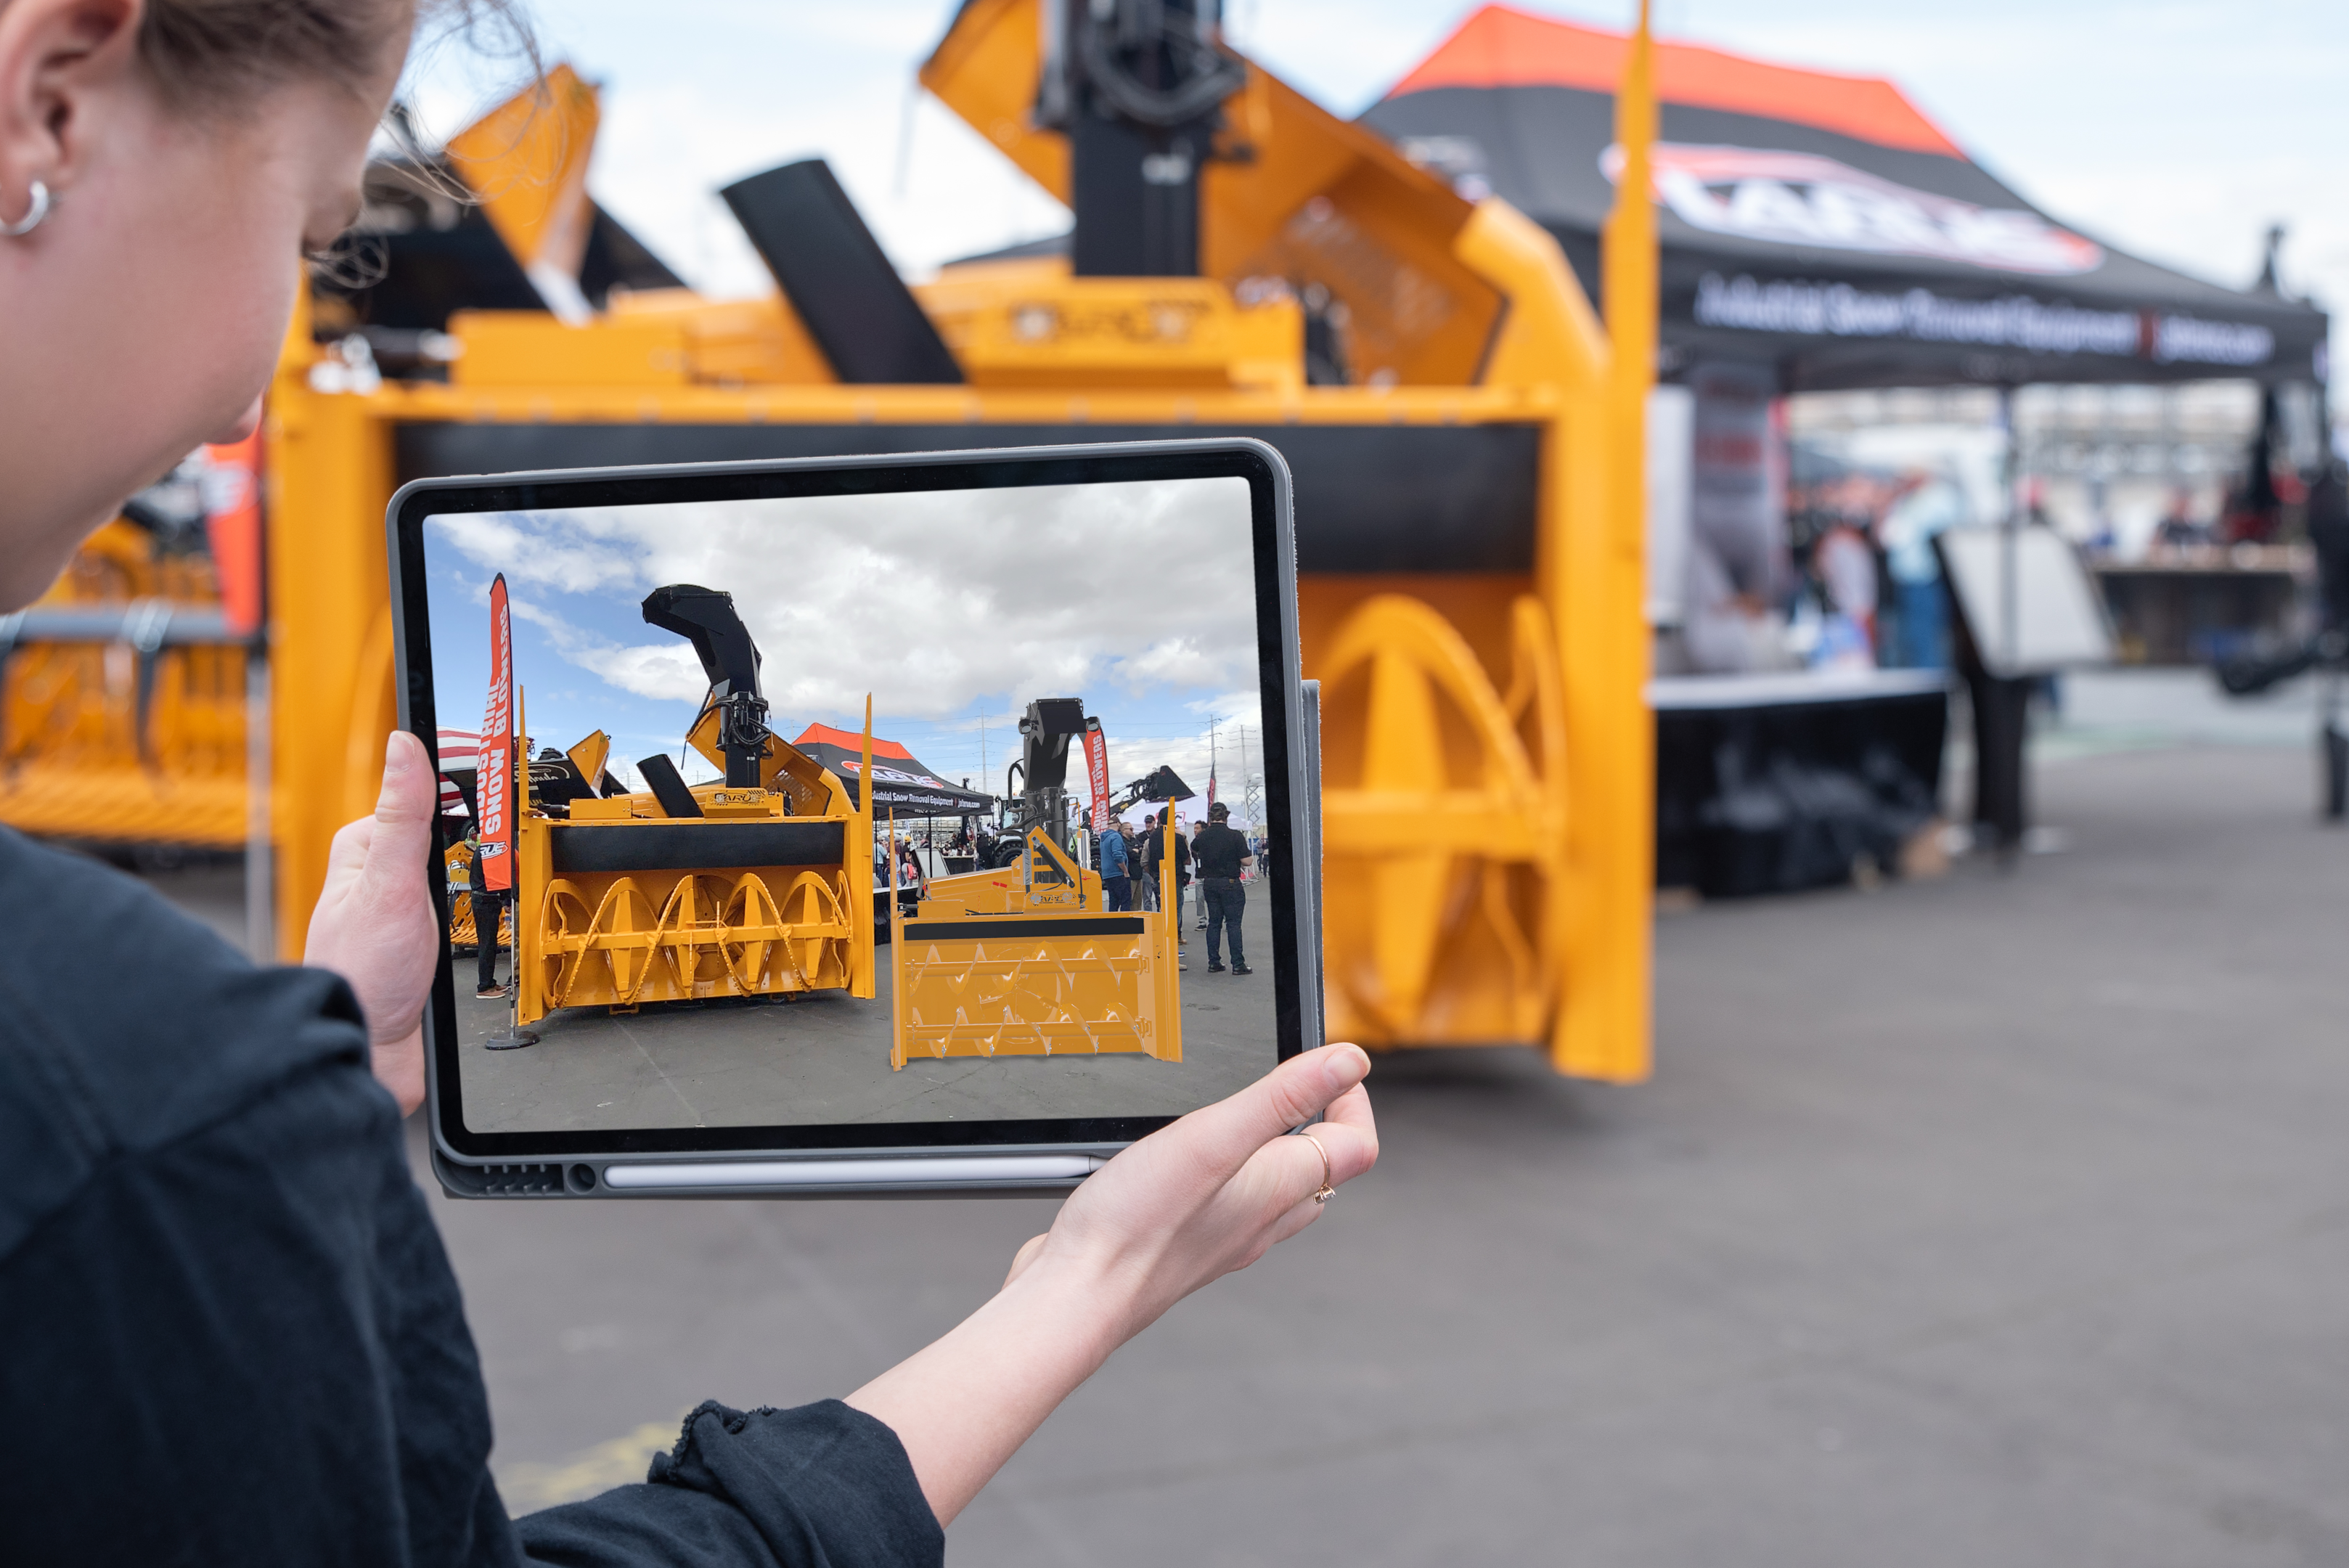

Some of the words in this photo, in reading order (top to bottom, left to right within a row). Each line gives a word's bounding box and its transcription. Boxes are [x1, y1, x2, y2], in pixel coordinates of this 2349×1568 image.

[493, 603, 508, 738] BLOWERS
[485, 748, 505, 836] SNOW
[872, 790, 892, 801] dustrial
[892, 792, 908, 802] Snow
[908, 793, 929, 804] Removal
[930, 796, 954, 806] Equipment
[1093, 735, 1105, 796] BLOWERS
